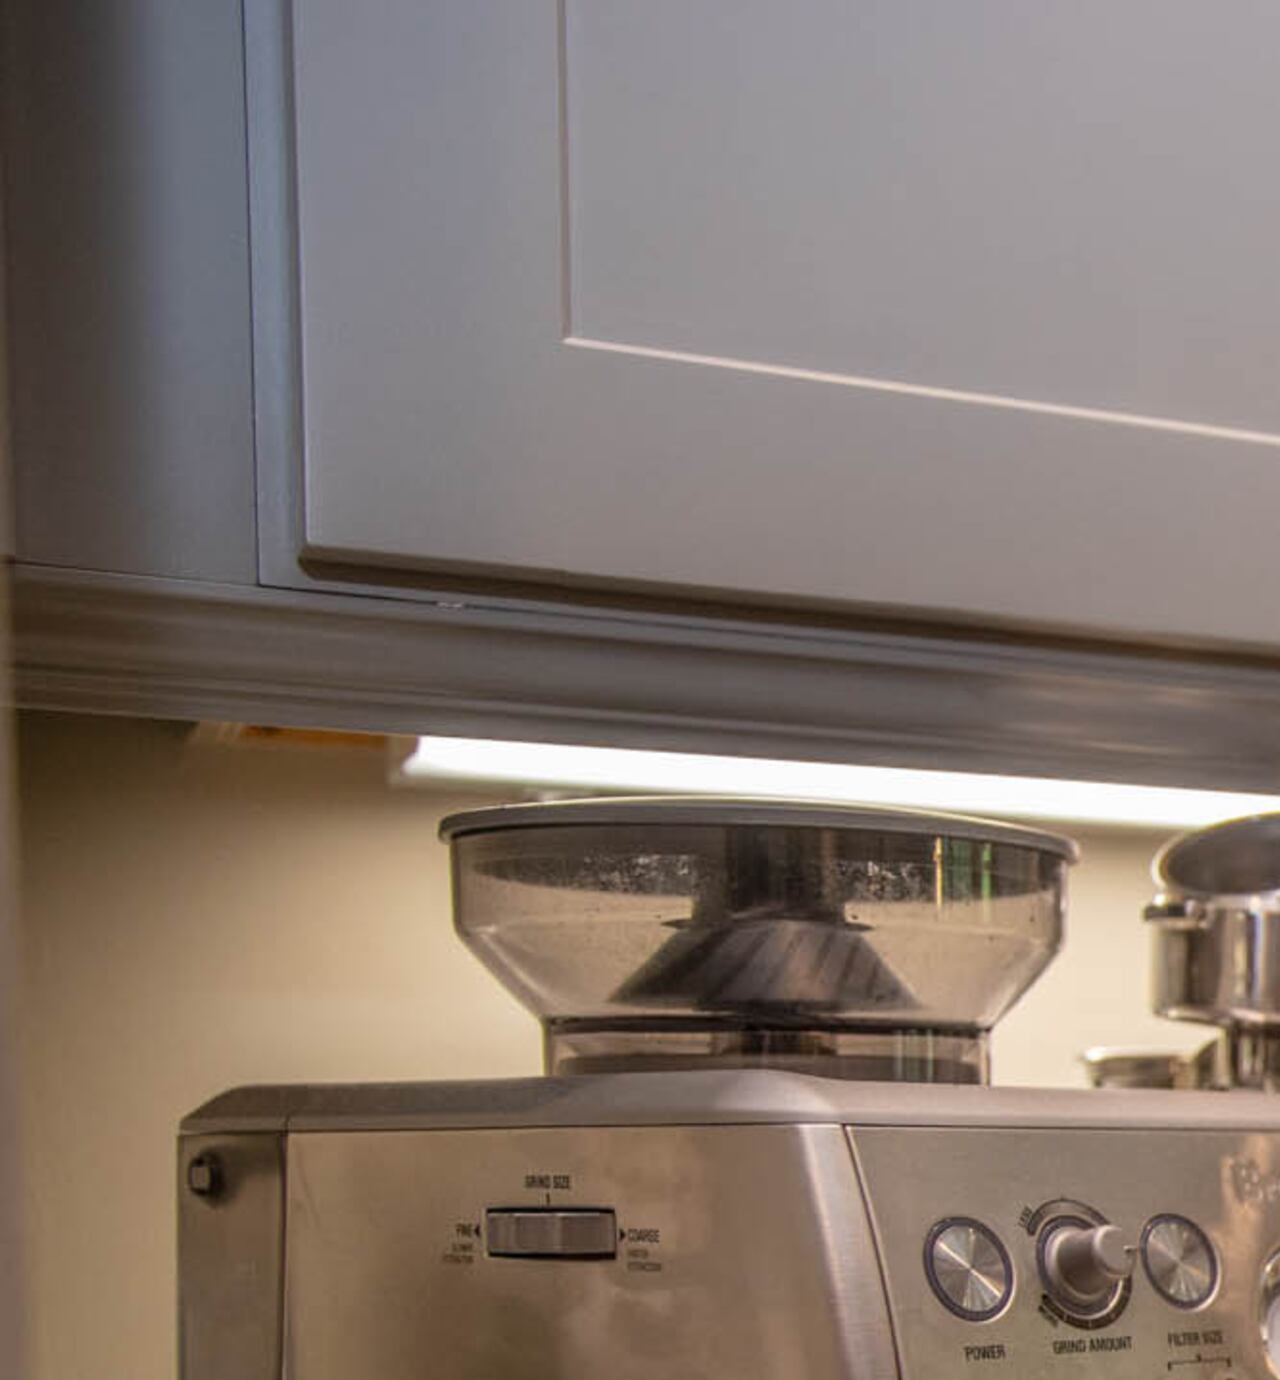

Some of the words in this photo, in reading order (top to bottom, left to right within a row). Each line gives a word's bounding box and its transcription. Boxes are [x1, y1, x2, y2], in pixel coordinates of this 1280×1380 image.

[964, 1345, 1006, 1361] POWER
[1052, 1339, 1086, 1354] GRIND
[1089, 1336, 1132, 1352] AMOUNT
